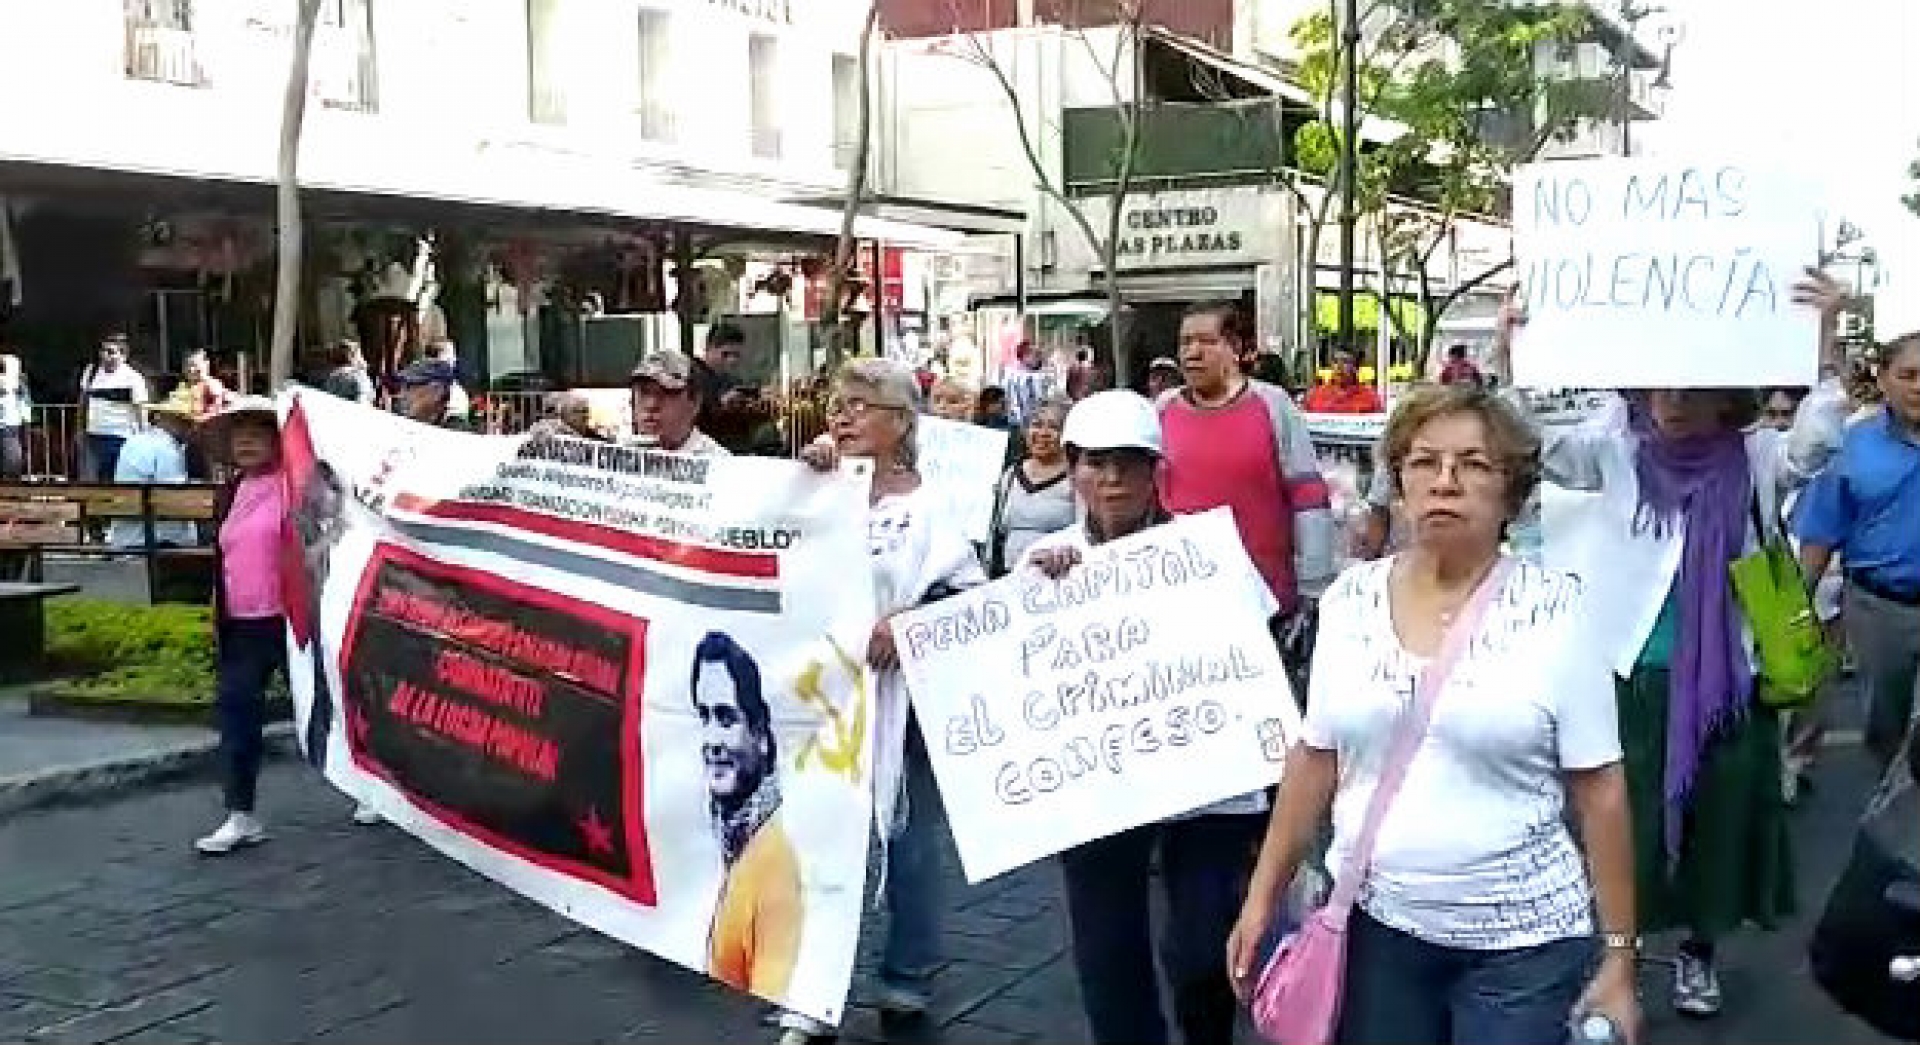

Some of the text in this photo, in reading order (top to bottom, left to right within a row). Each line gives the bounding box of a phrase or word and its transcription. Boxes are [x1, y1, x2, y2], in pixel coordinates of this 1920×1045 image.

[1127, 206, 1218, 229] CENTRO
[1534, 175, 1591, 229] NO
[1151, 231, 1242, 252] PLAZAS
[945, 692, 1006, 756] EL
